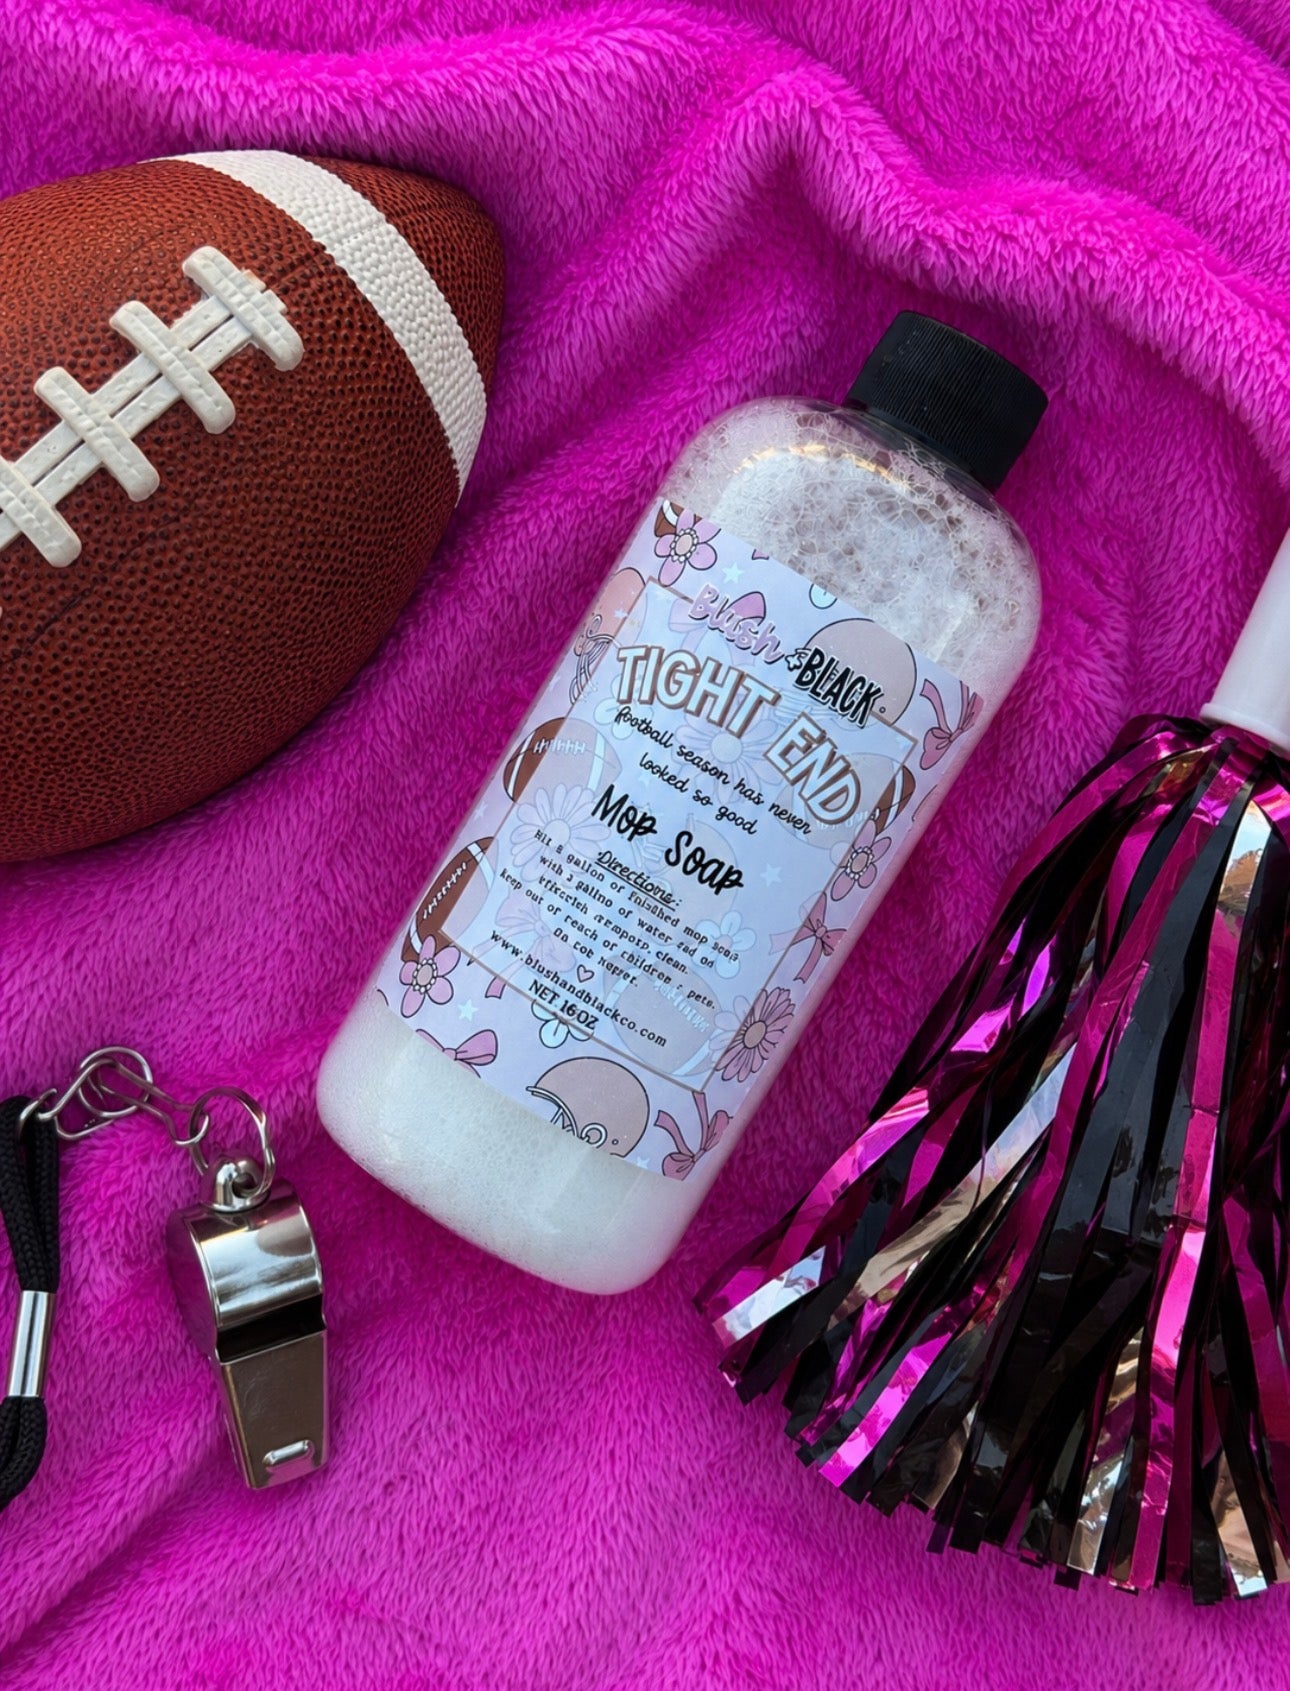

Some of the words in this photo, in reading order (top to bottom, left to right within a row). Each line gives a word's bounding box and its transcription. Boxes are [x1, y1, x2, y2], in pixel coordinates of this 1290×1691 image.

[687, 582, 782, 666] Blush
[792, 645, 884, 729] BLACK
[614, 704, 673, 748] football
[676, 744, 729, 784] season
[733, 777, 764, 805] has
[768, 803, 811, 834] never
[617, 646, 781, 740] TIGHT
[764, 711, 861, 827] END
[639, 752, 689, 792] looked
[692, 789, 712, 806] so
[715, 806, 757, 834] good
[591, 784, 657, 841] Mop
[664, 830, 743, 895] Soap
[490, 930, 666, 1046] www.blushandblackco.com
[637, 918, 672, 942] water
